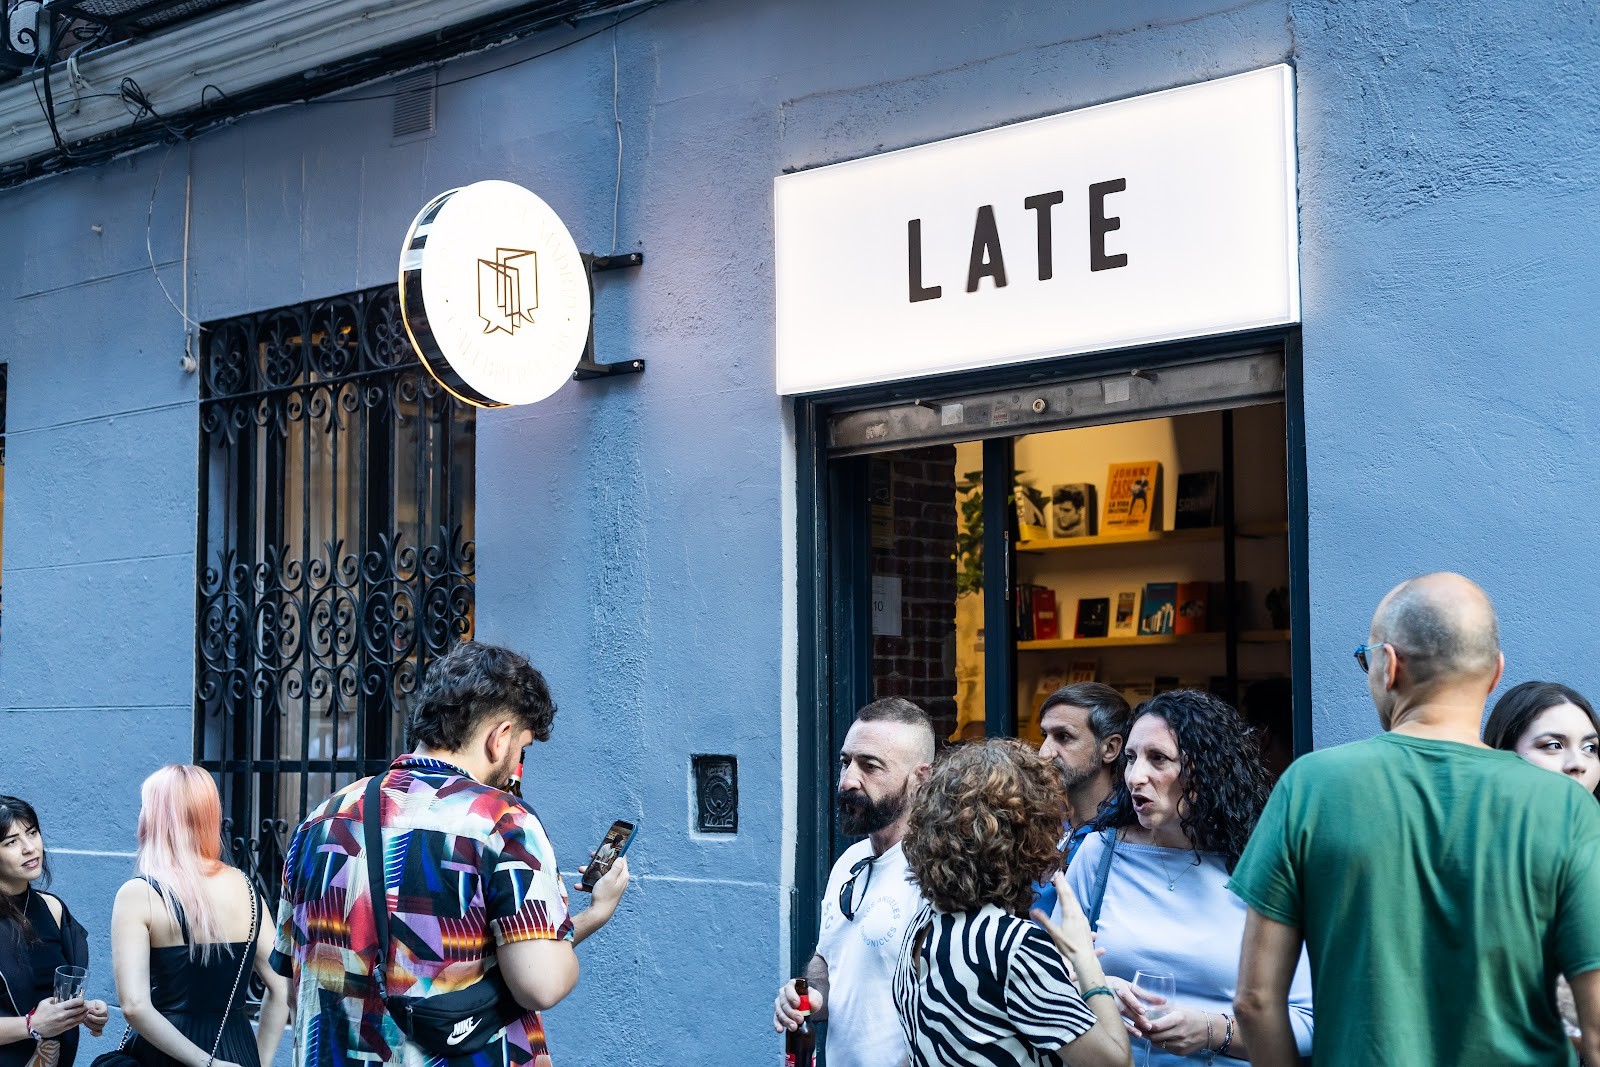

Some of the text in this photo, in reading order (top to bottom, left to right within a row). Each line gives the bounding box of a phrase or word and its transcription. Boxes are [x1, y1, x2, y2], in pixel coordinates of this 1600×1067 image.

[908, 178, 1128, 303] LATE
[1114, 467, 1151, 479] JOHNNY
[877, 895, 900, 920] ANGELES
[861, 925, 897, 948] CHRONICLES
[453, 1015, 474, 1037] NIKE
